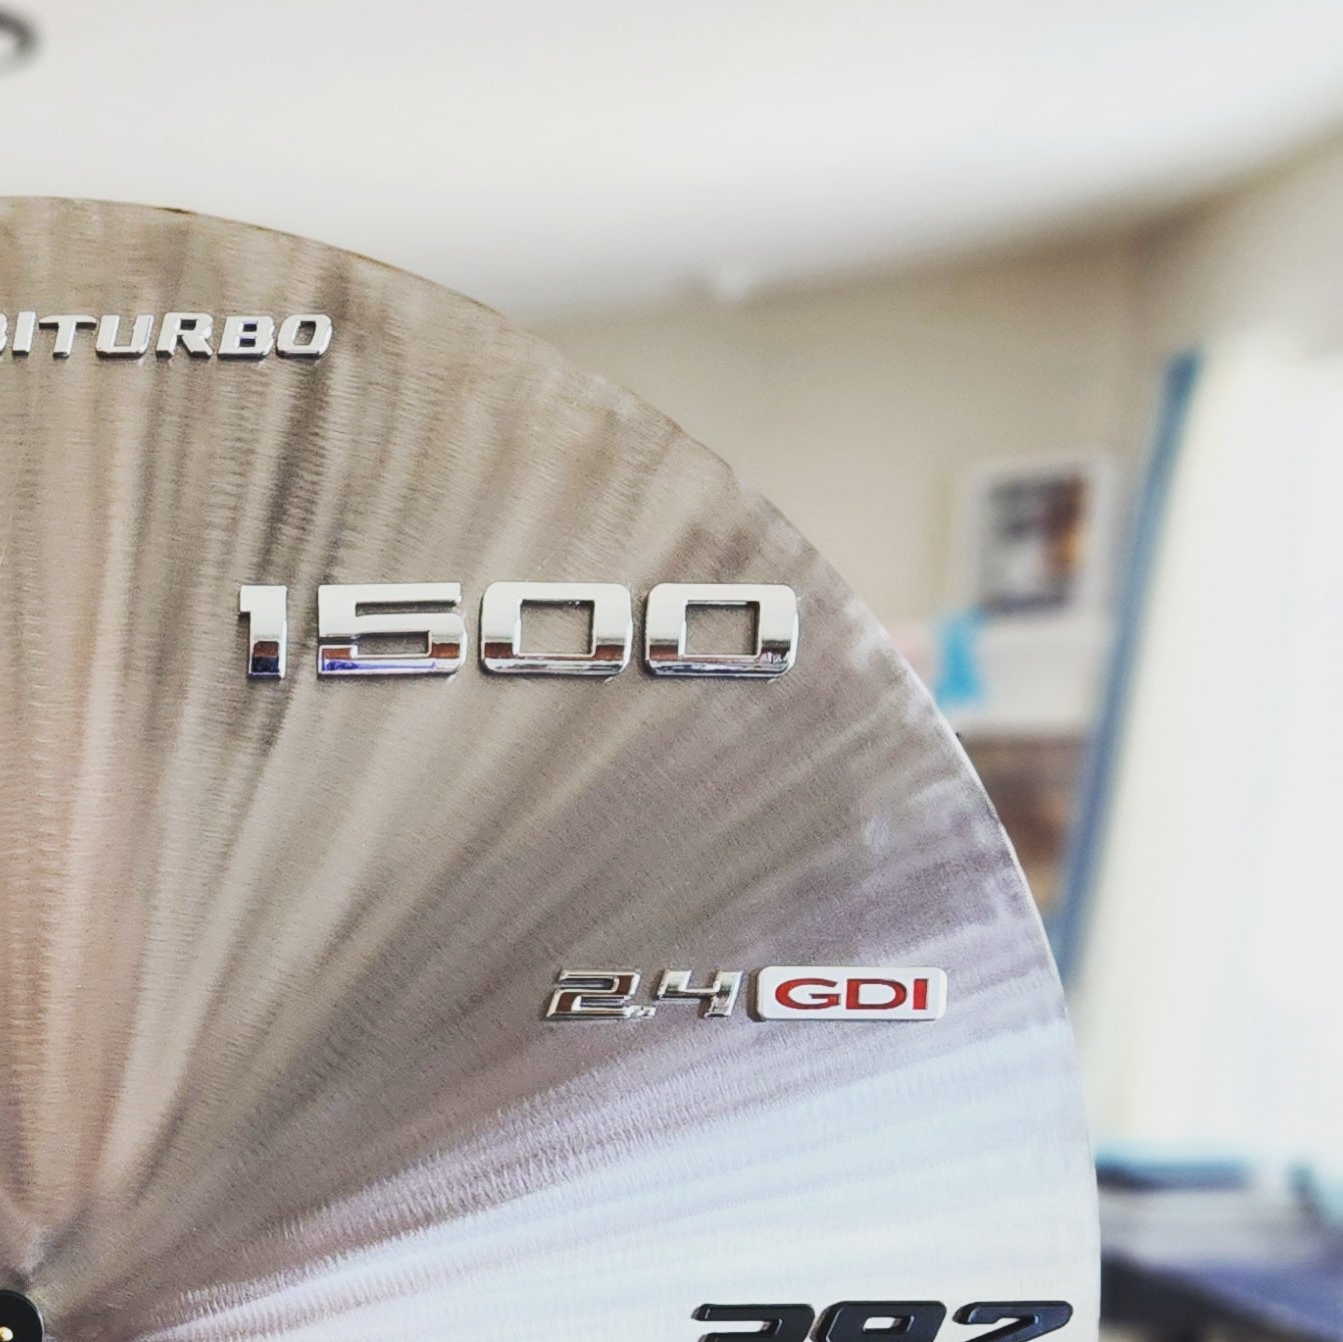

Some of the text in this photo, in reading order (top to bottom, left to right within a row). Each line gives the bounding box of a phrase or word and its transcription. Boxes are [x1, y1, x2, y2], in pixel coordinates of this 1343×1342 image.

[239, 582, 798, 678] 1500
[545, 967, 931, 1019] 2.4 GDI
